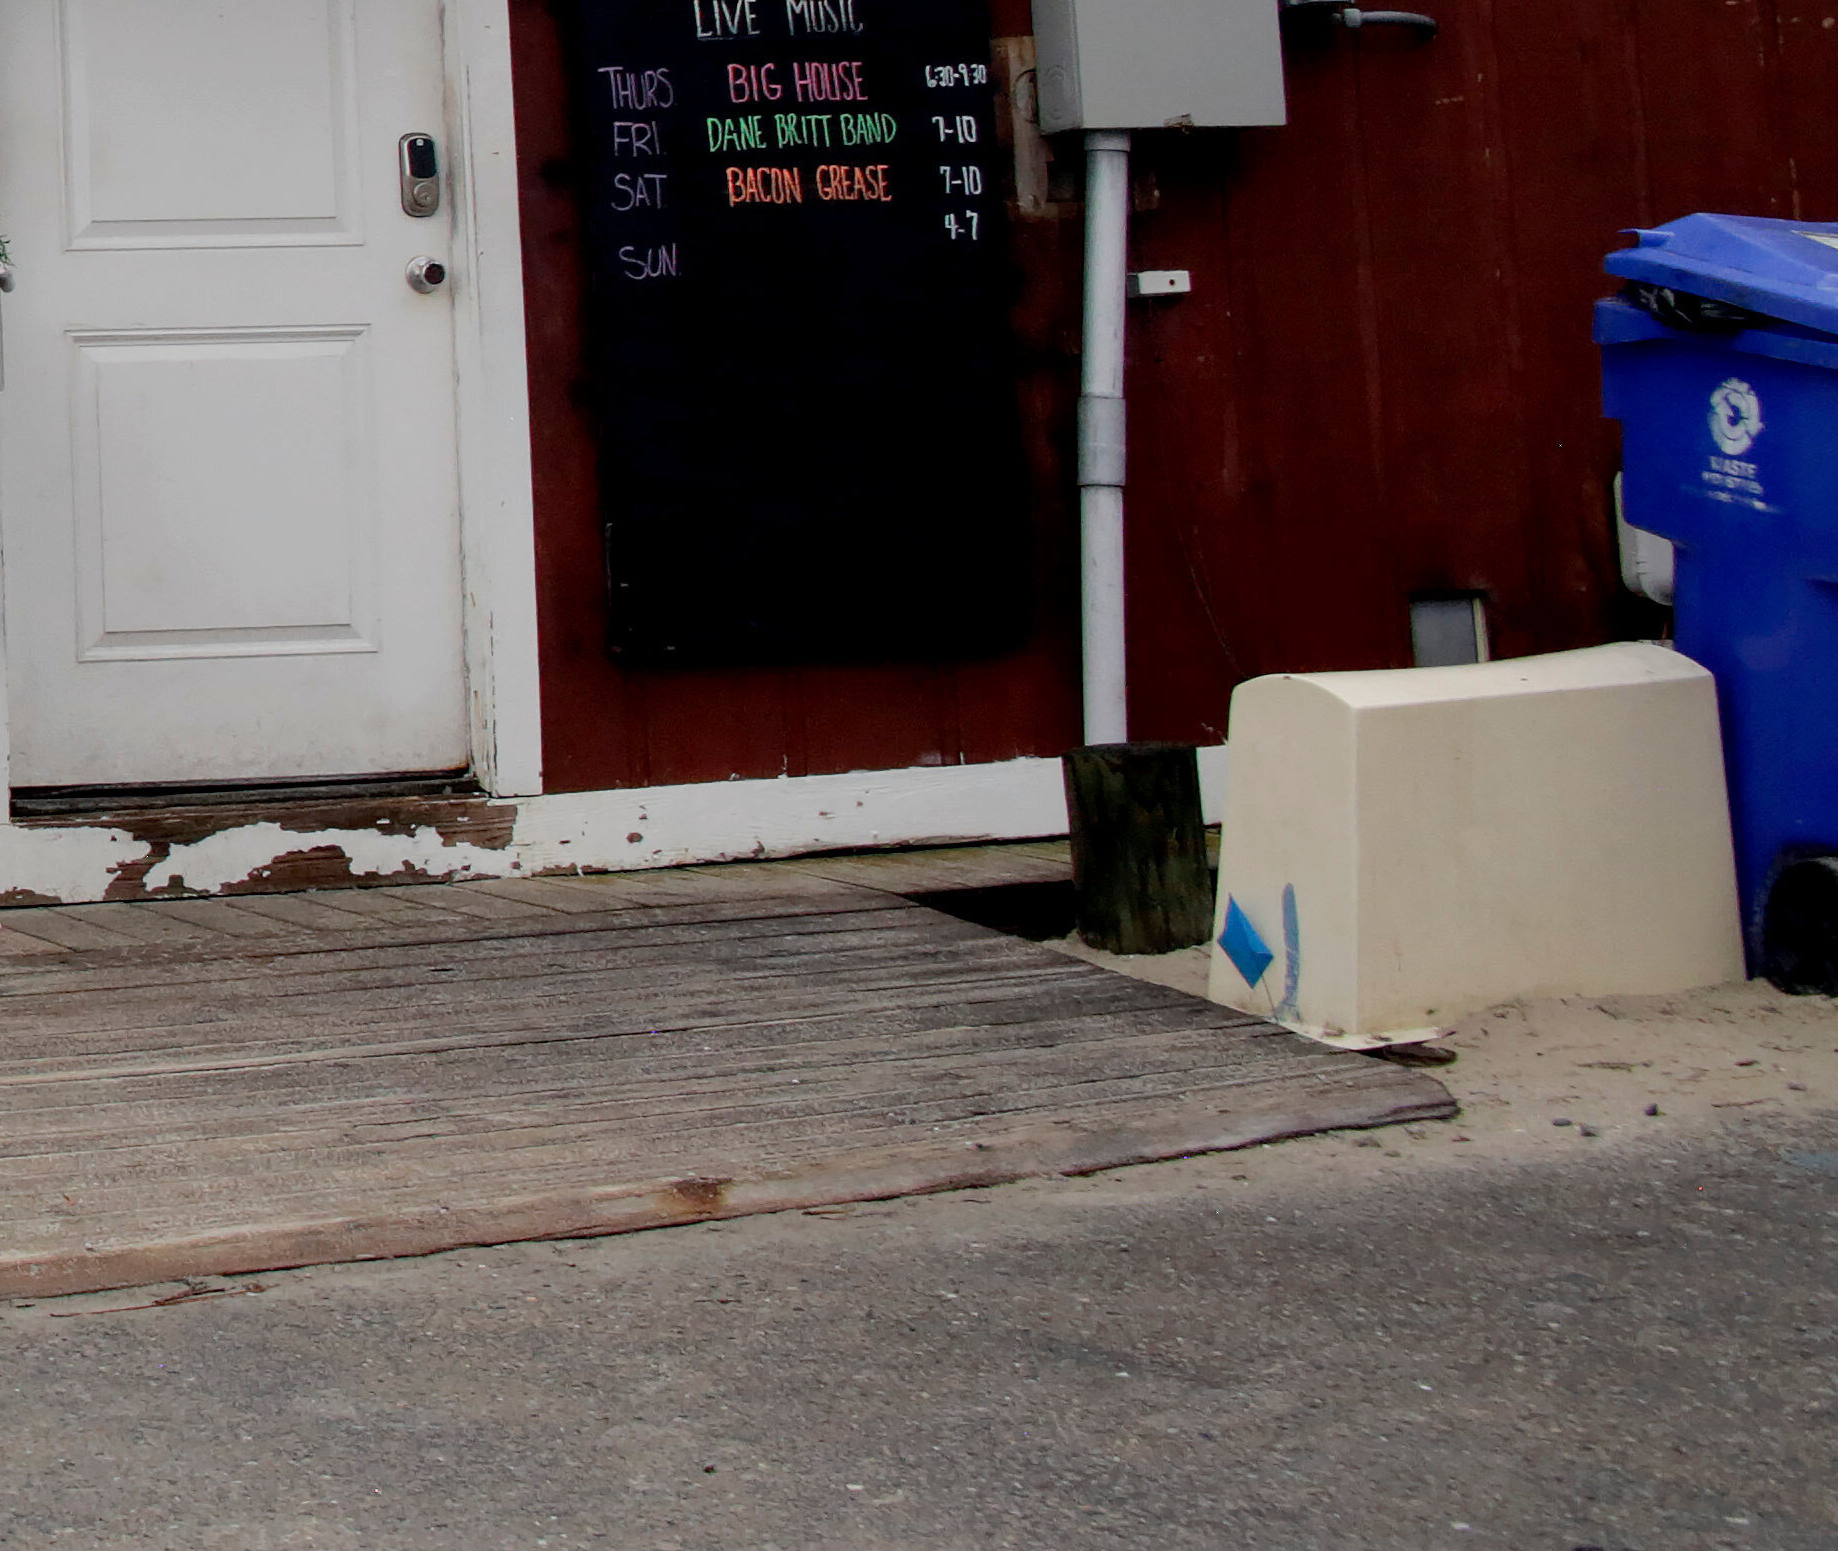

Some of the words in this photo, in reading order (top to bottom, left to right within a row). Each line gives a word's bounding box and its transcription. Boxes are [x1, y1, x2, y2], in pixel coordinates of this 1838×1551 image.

[727, 63, 782, 103] BIG
[793, 61, 869, 102] HOUSE
[707, 115, 767, 153] DANE
[775, 113, 832, 150] BRITT
[840, 112, 897, 147] BAND
[931, 115, 977, 144] 7-10
[726, 167, 802, 207] BACON
[816, 164, 892, 203] GREASE
[940, 165, 982, 196] 7-10
[944, 210, 979, 241] 4-7
